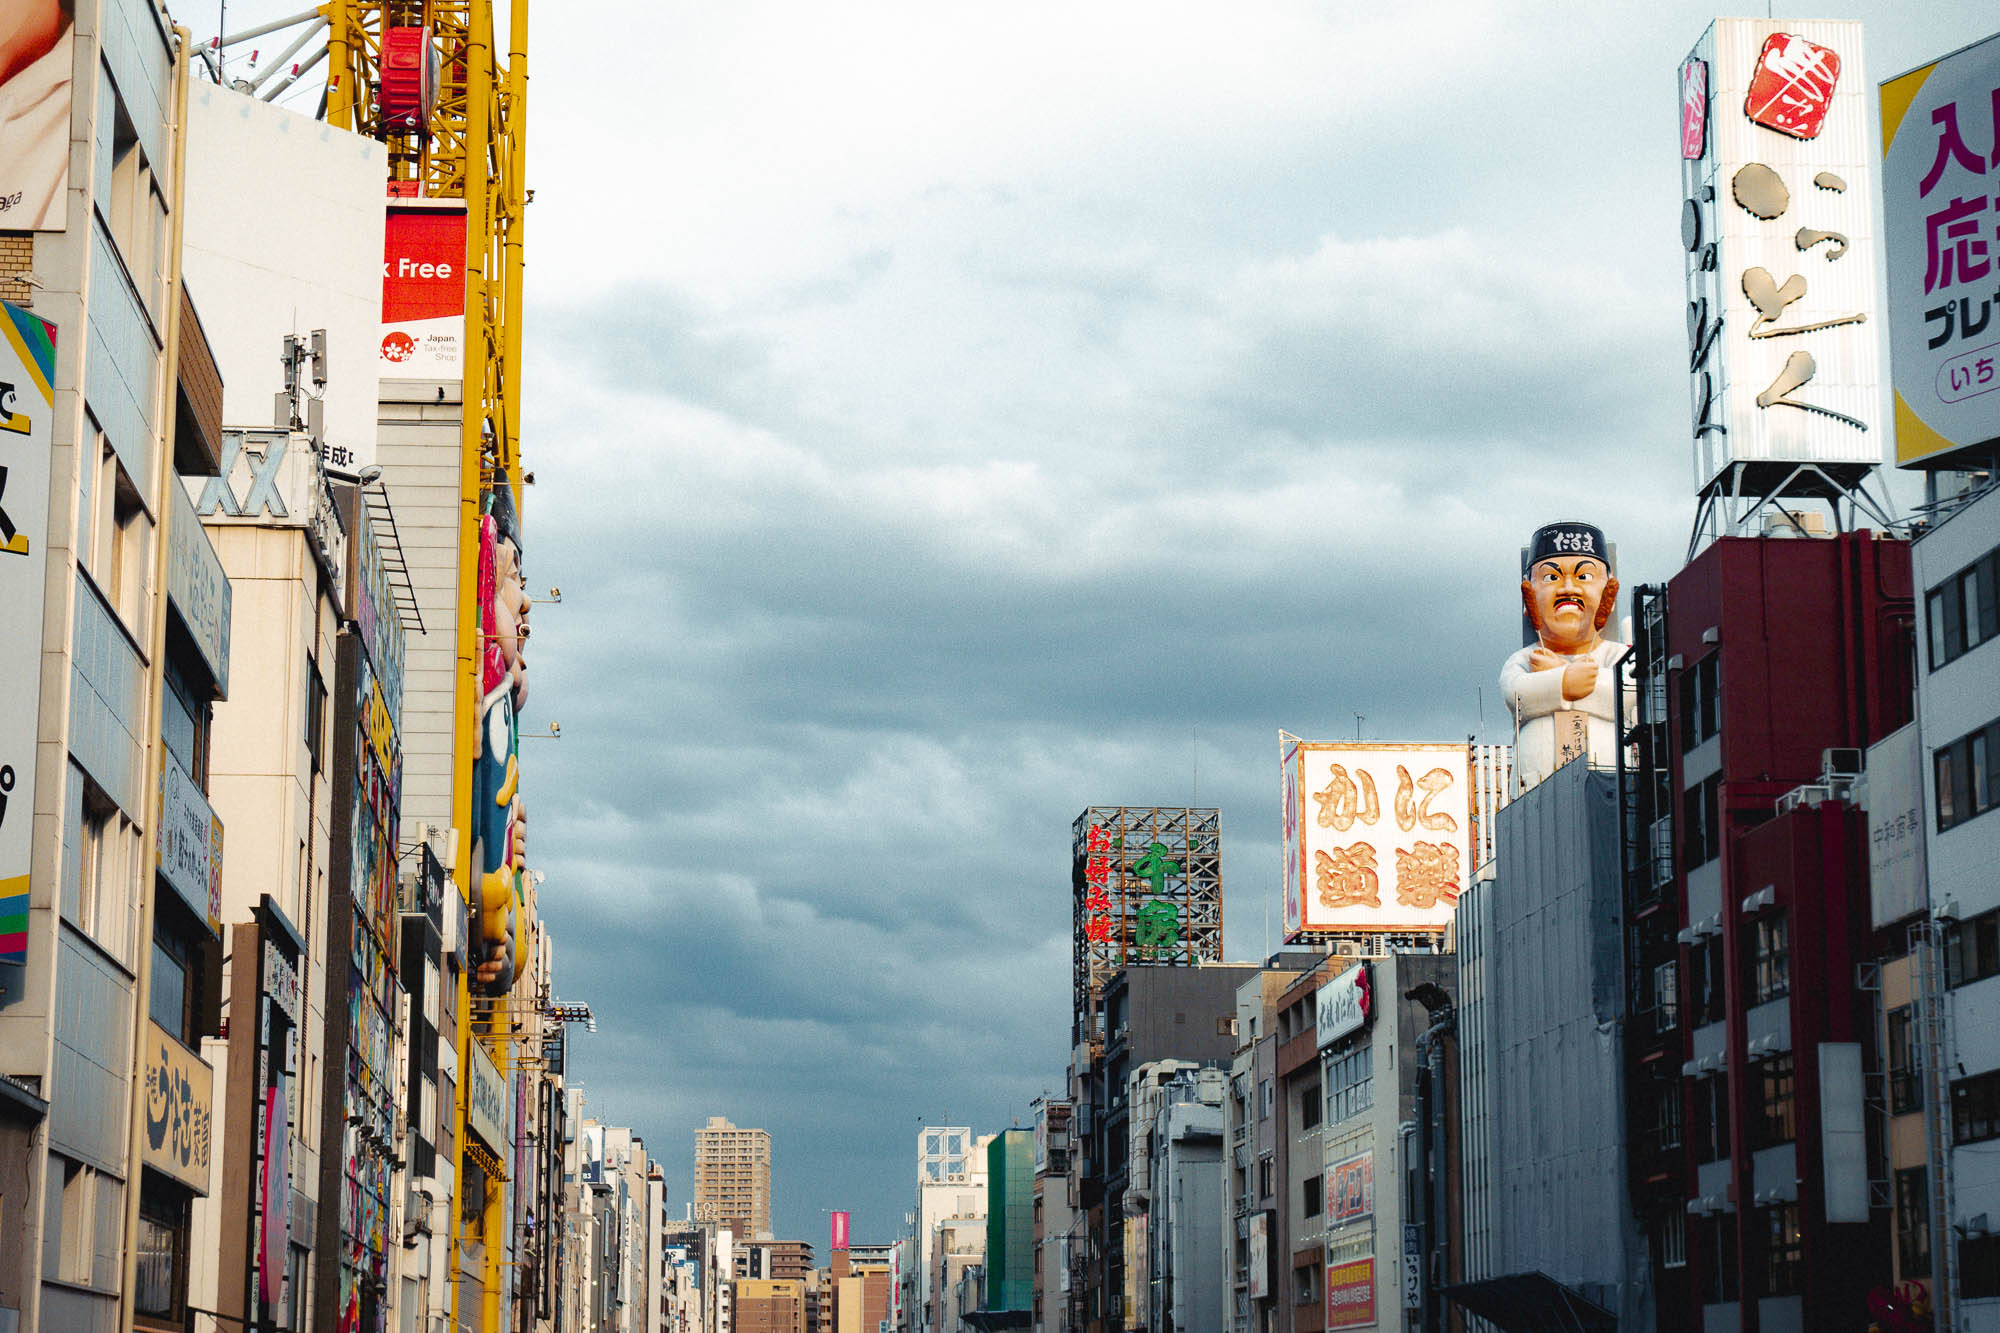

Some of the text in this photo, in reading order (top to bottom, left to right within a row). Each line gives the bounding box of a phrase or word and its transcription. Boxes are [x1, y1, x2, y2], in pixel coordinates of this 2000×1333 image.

[398, 258, 452, 279] Free
[1553, 531, 1595, 553] だるま
[1313, 764, 1457, 832] かに
[1084, 825, 1114, 943] お好み焼
[1133, 842, 1180, 947] 千房
[1406, 1256, 1418, 1307] いろりや
